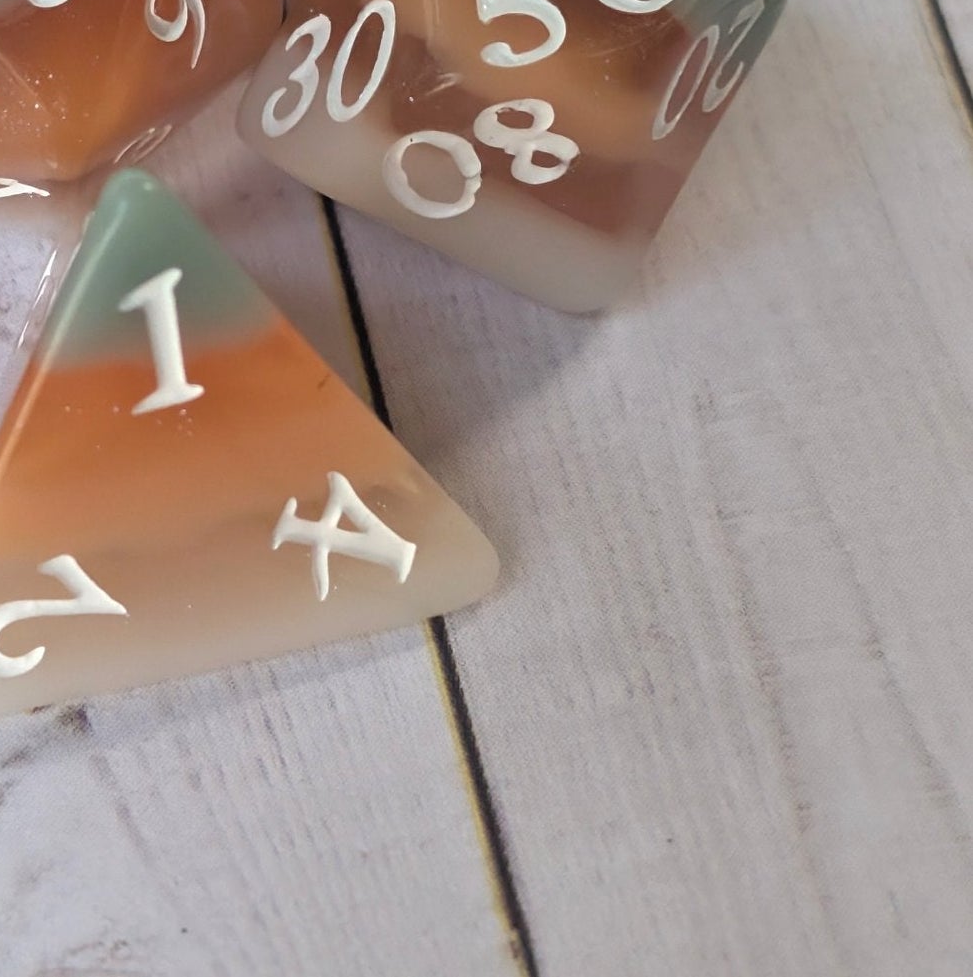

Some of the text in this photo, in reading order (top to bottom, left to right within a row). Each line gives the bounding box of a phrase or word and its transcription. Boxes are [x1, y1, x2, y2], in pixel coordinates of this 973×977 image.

[382, 98, 580, 219] 80
[118, 267, 205, 416] 1
[272, 471, 417, 601] 4
